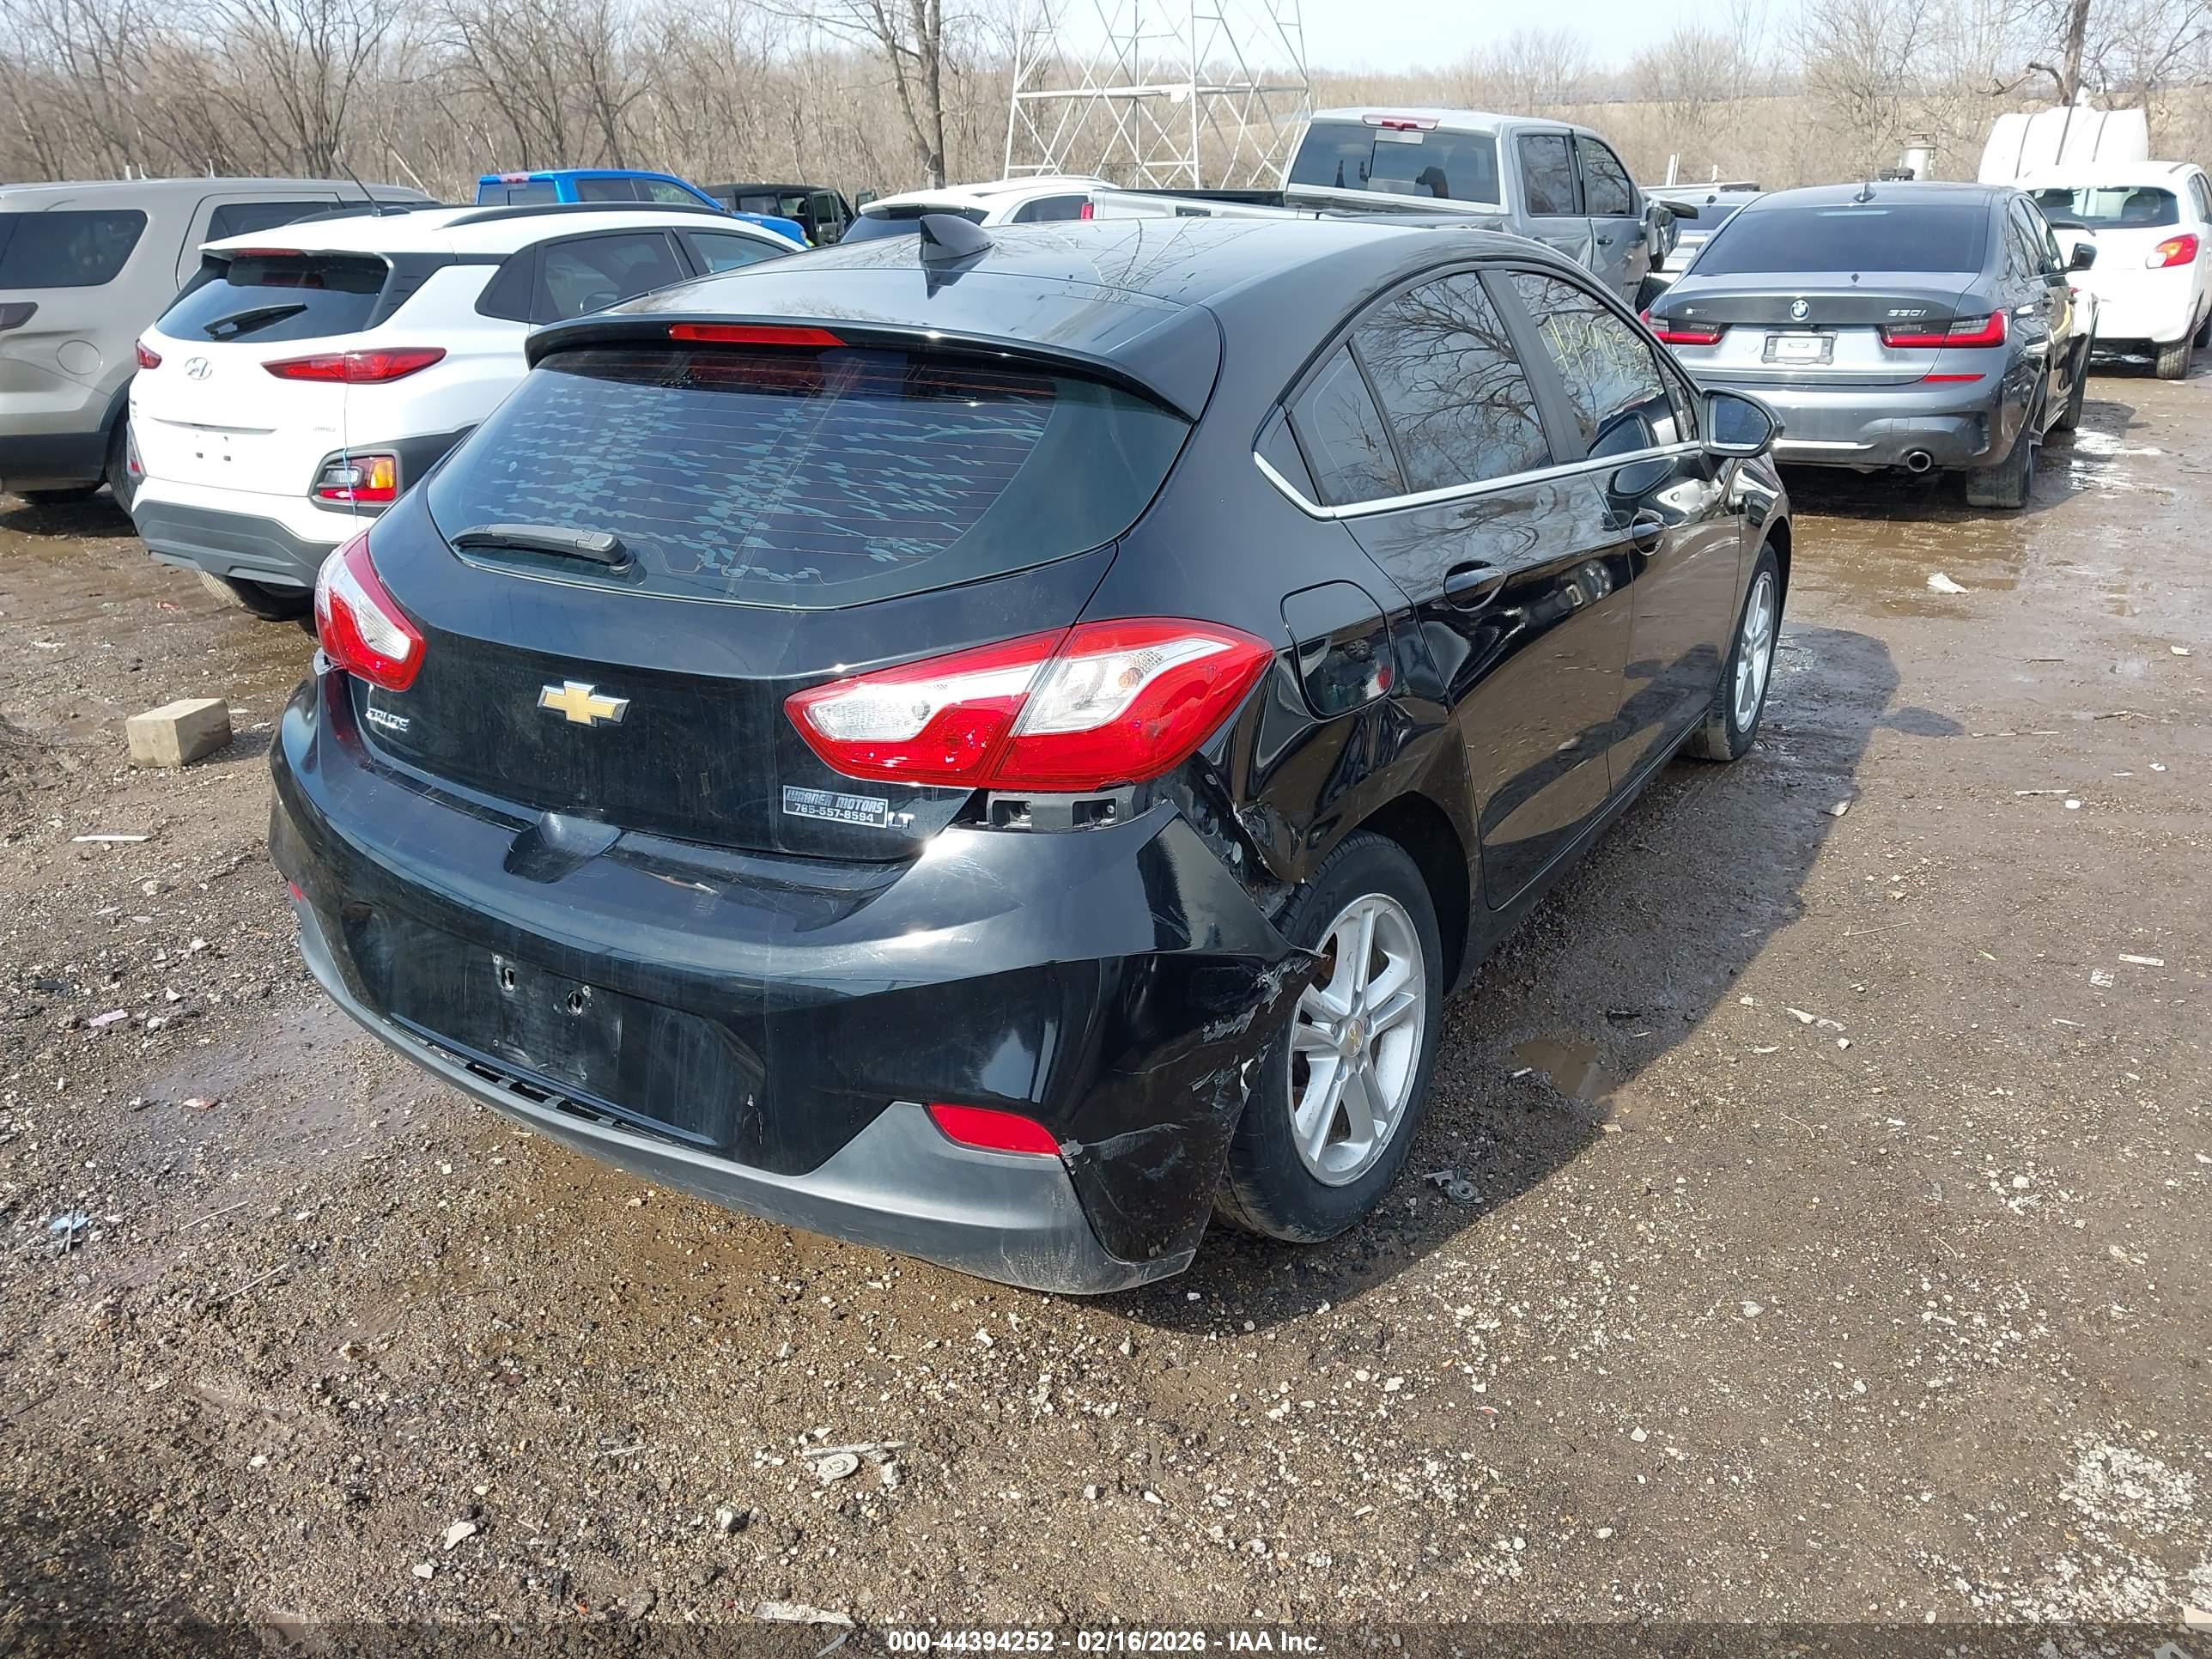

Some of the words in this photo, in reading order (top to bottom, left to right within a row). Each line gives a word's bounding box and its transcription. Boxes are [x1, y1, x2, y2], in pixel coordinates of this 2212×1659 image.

[364, 707, 410, 732] CRUZE
[794, 803, 874, 823] 765-557-8594
[836, 796, 885, 814] MOTORS
[888, 811, 915, 830] LT
